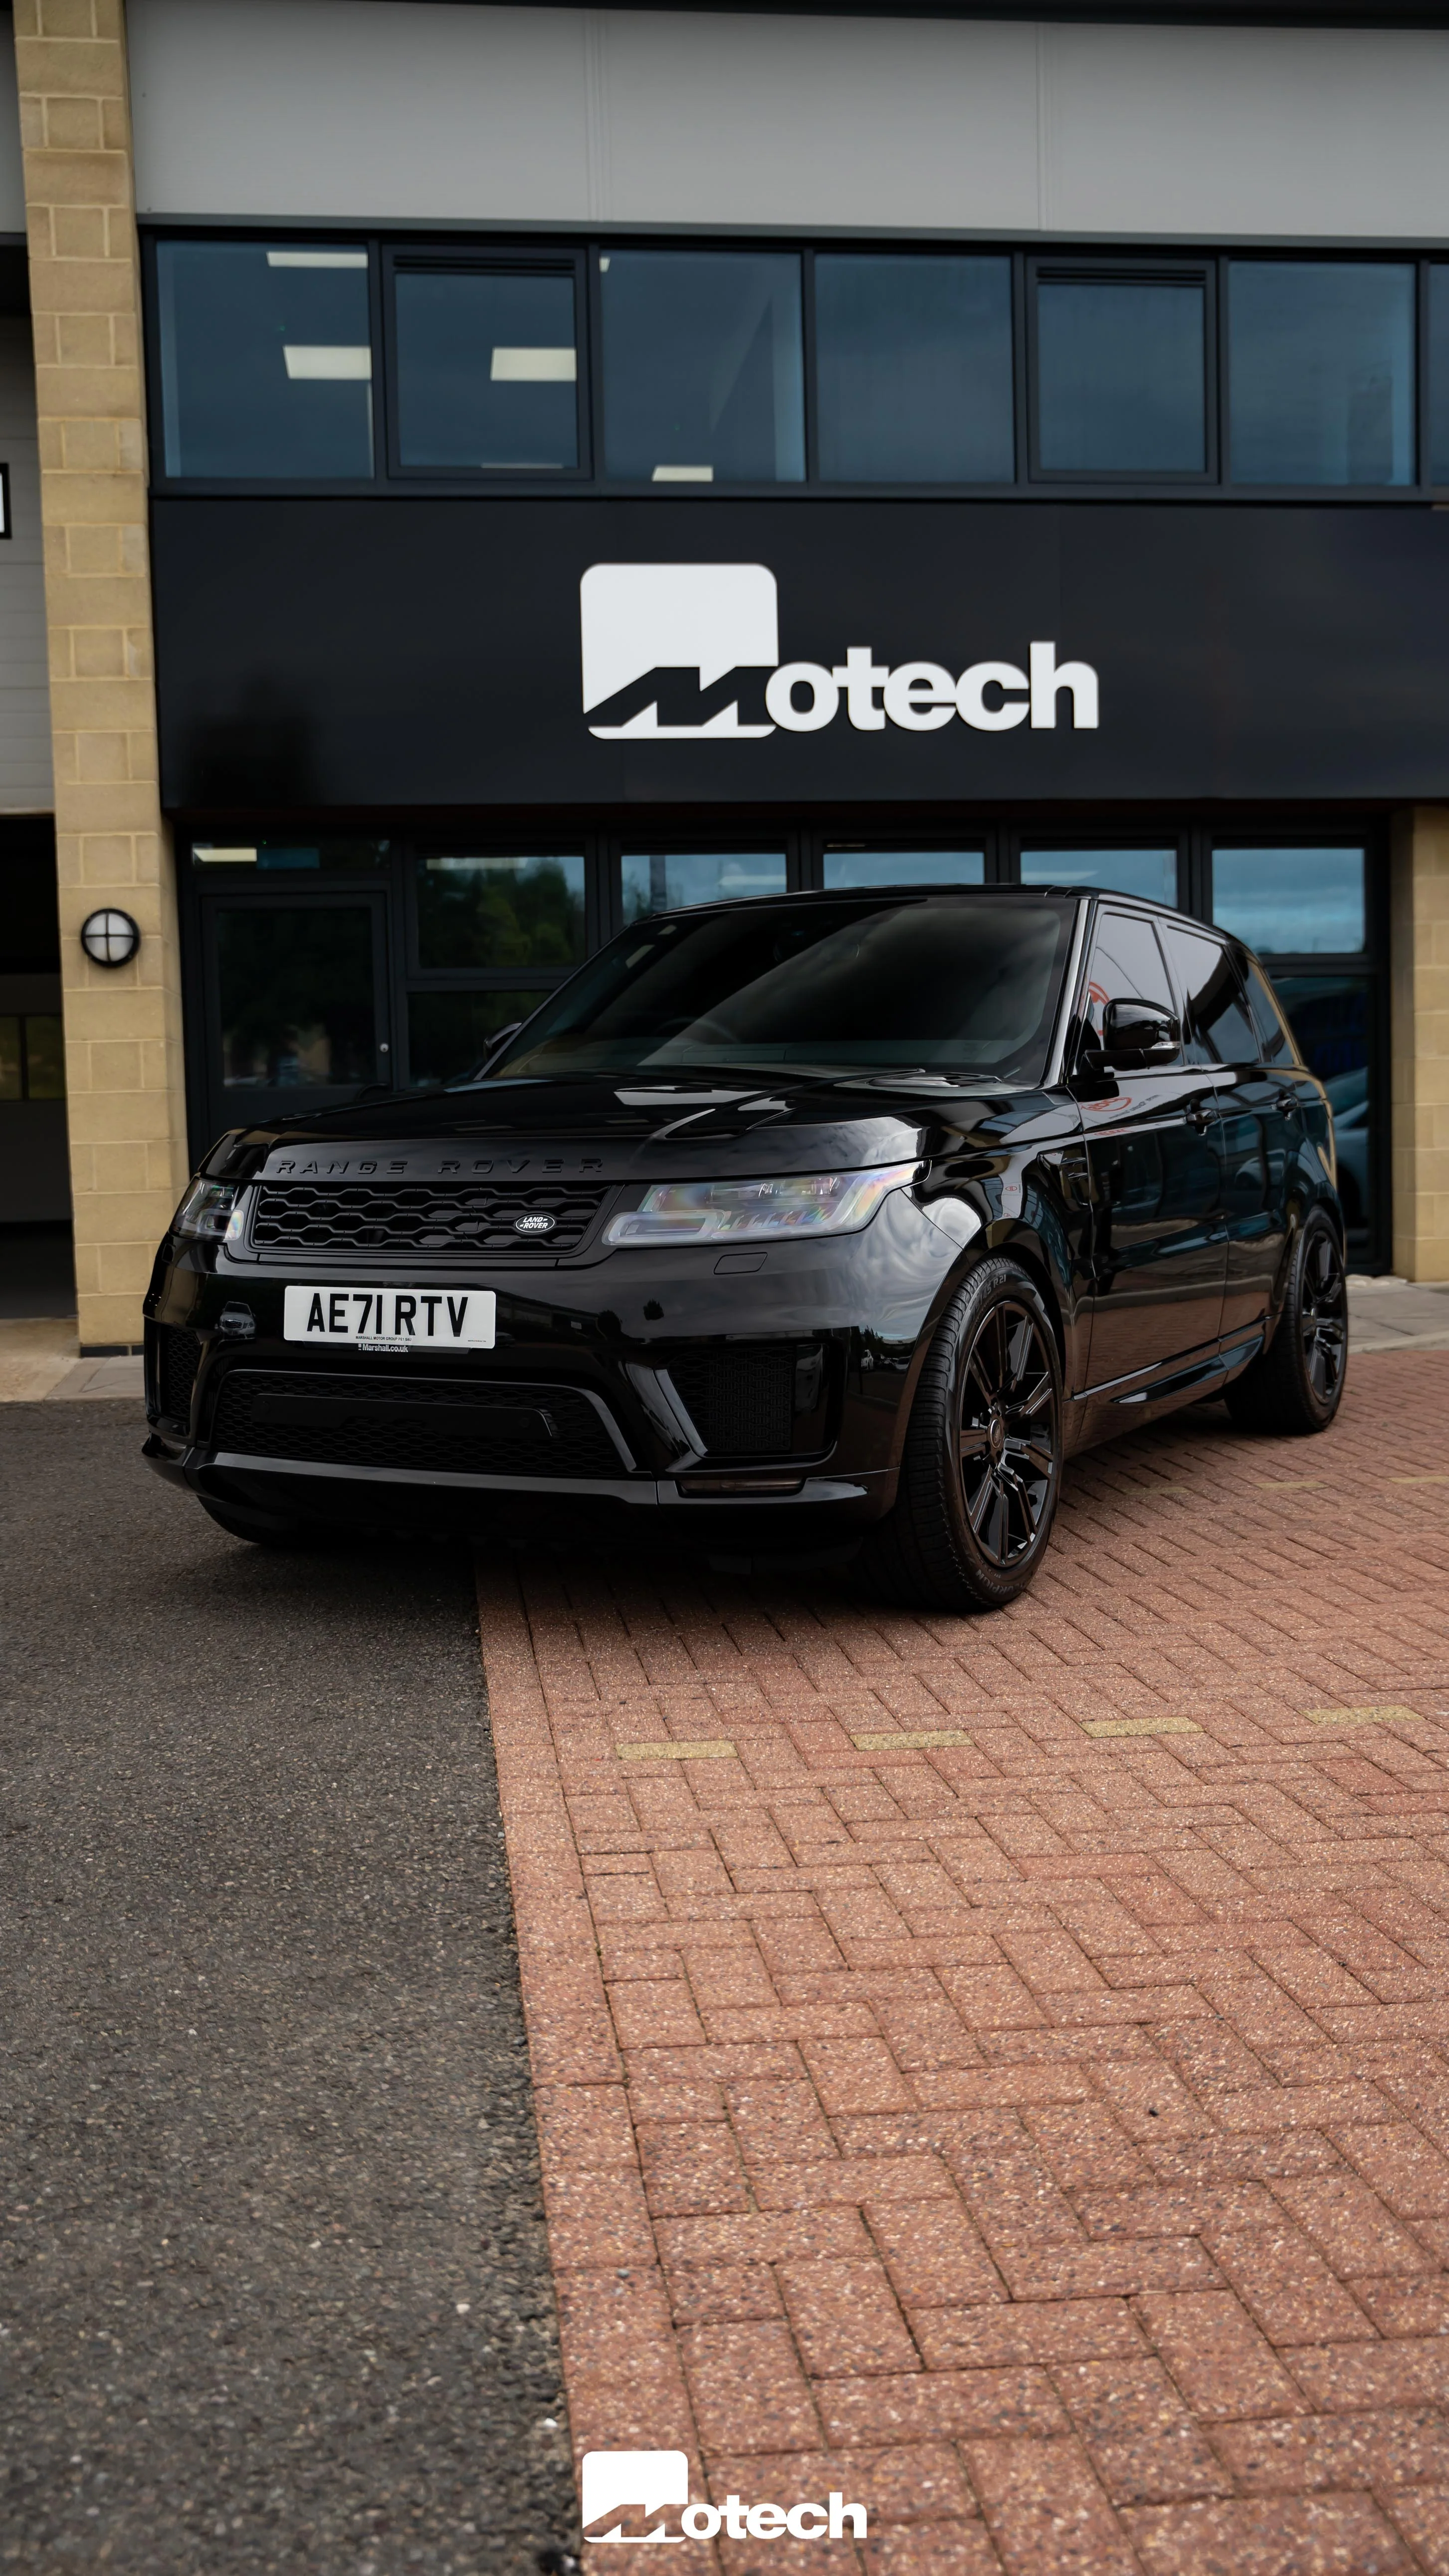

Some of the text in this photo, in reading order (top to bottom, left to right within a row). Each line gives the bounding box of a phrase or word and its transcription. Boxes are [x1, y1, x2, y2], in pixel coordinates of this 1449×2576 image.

[275, 1159, 603, 1174] RANGE ROVER
[307, 1293, 469, 1337] AE71 RTV
[362, 1343, 409, 1353] Marshall.co.uk
